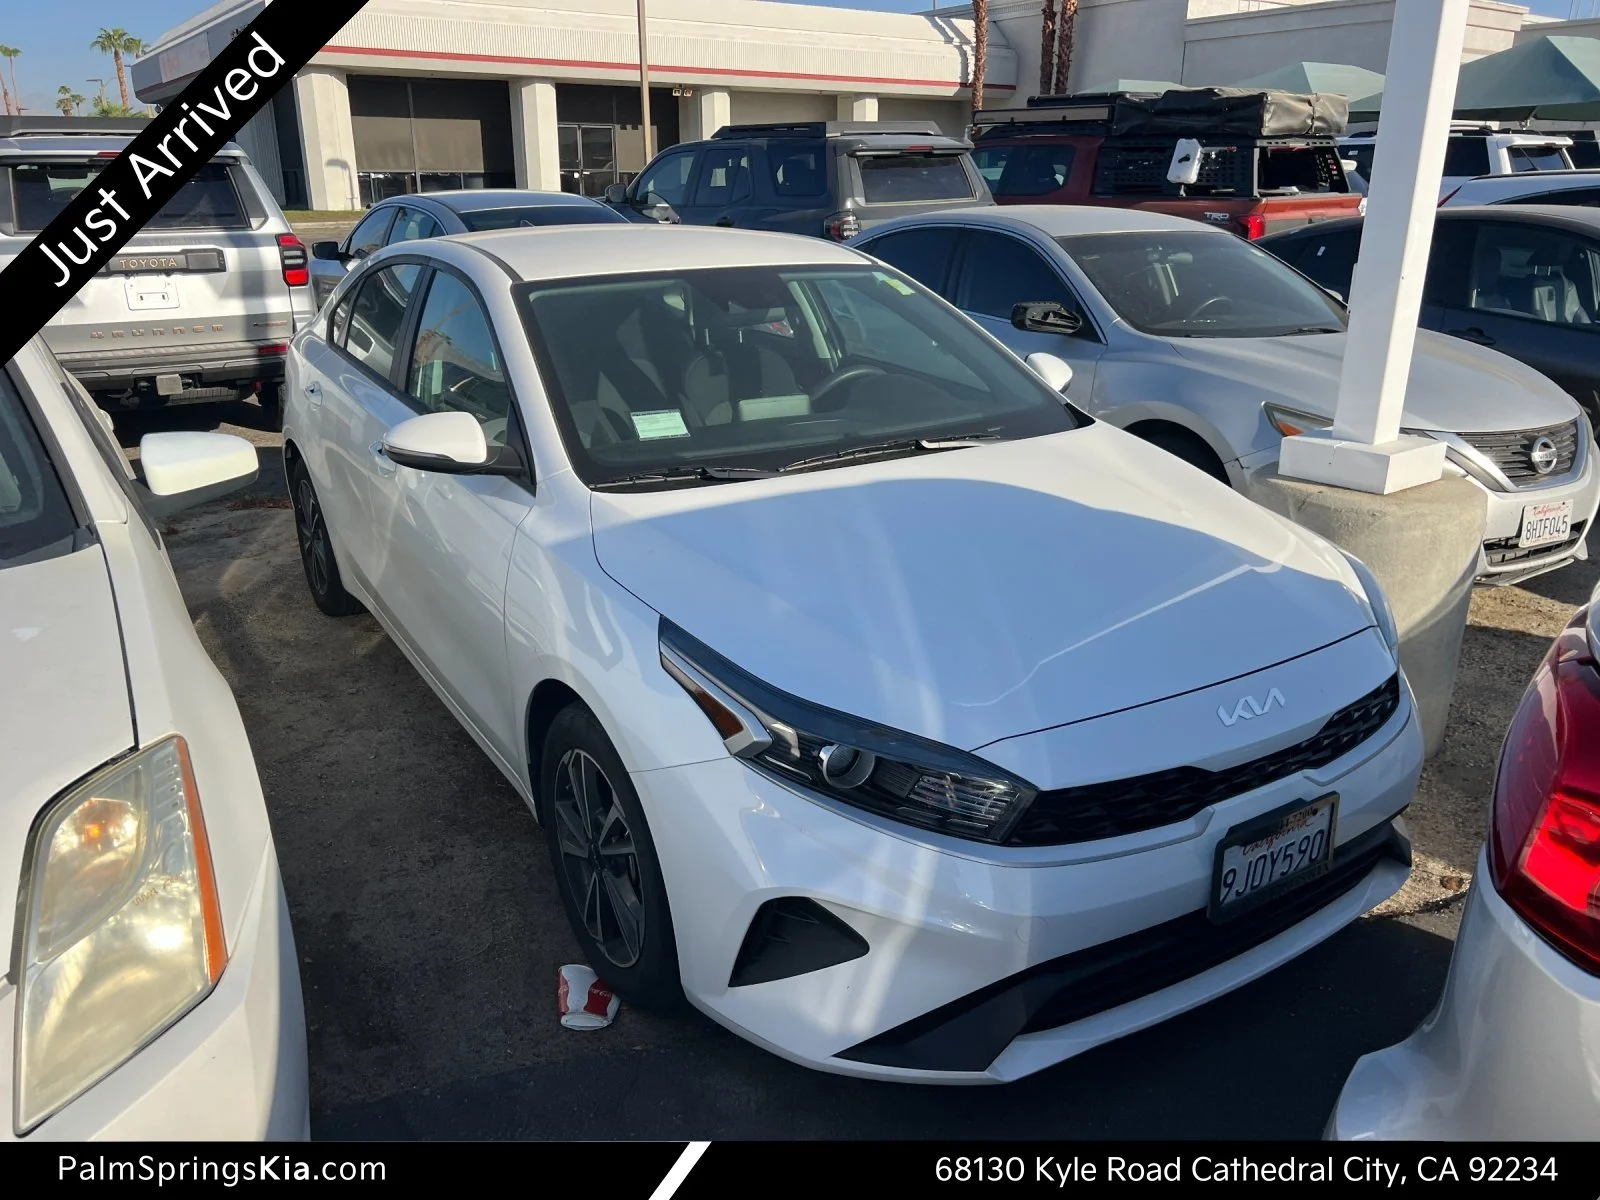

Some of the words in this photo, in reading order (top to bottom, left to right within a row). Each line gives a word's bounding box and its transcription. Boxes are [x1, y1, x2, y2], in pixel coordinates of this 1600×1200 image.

[1203, 211, 1230, 221] TRD
[119, 258, 178, 269] TOYOTA
[90, 323, 224, 340] 4RUNNER
[1525, 514, 1569, 541] 8HIF045
[1217, 687, 1286, 727] KIA
